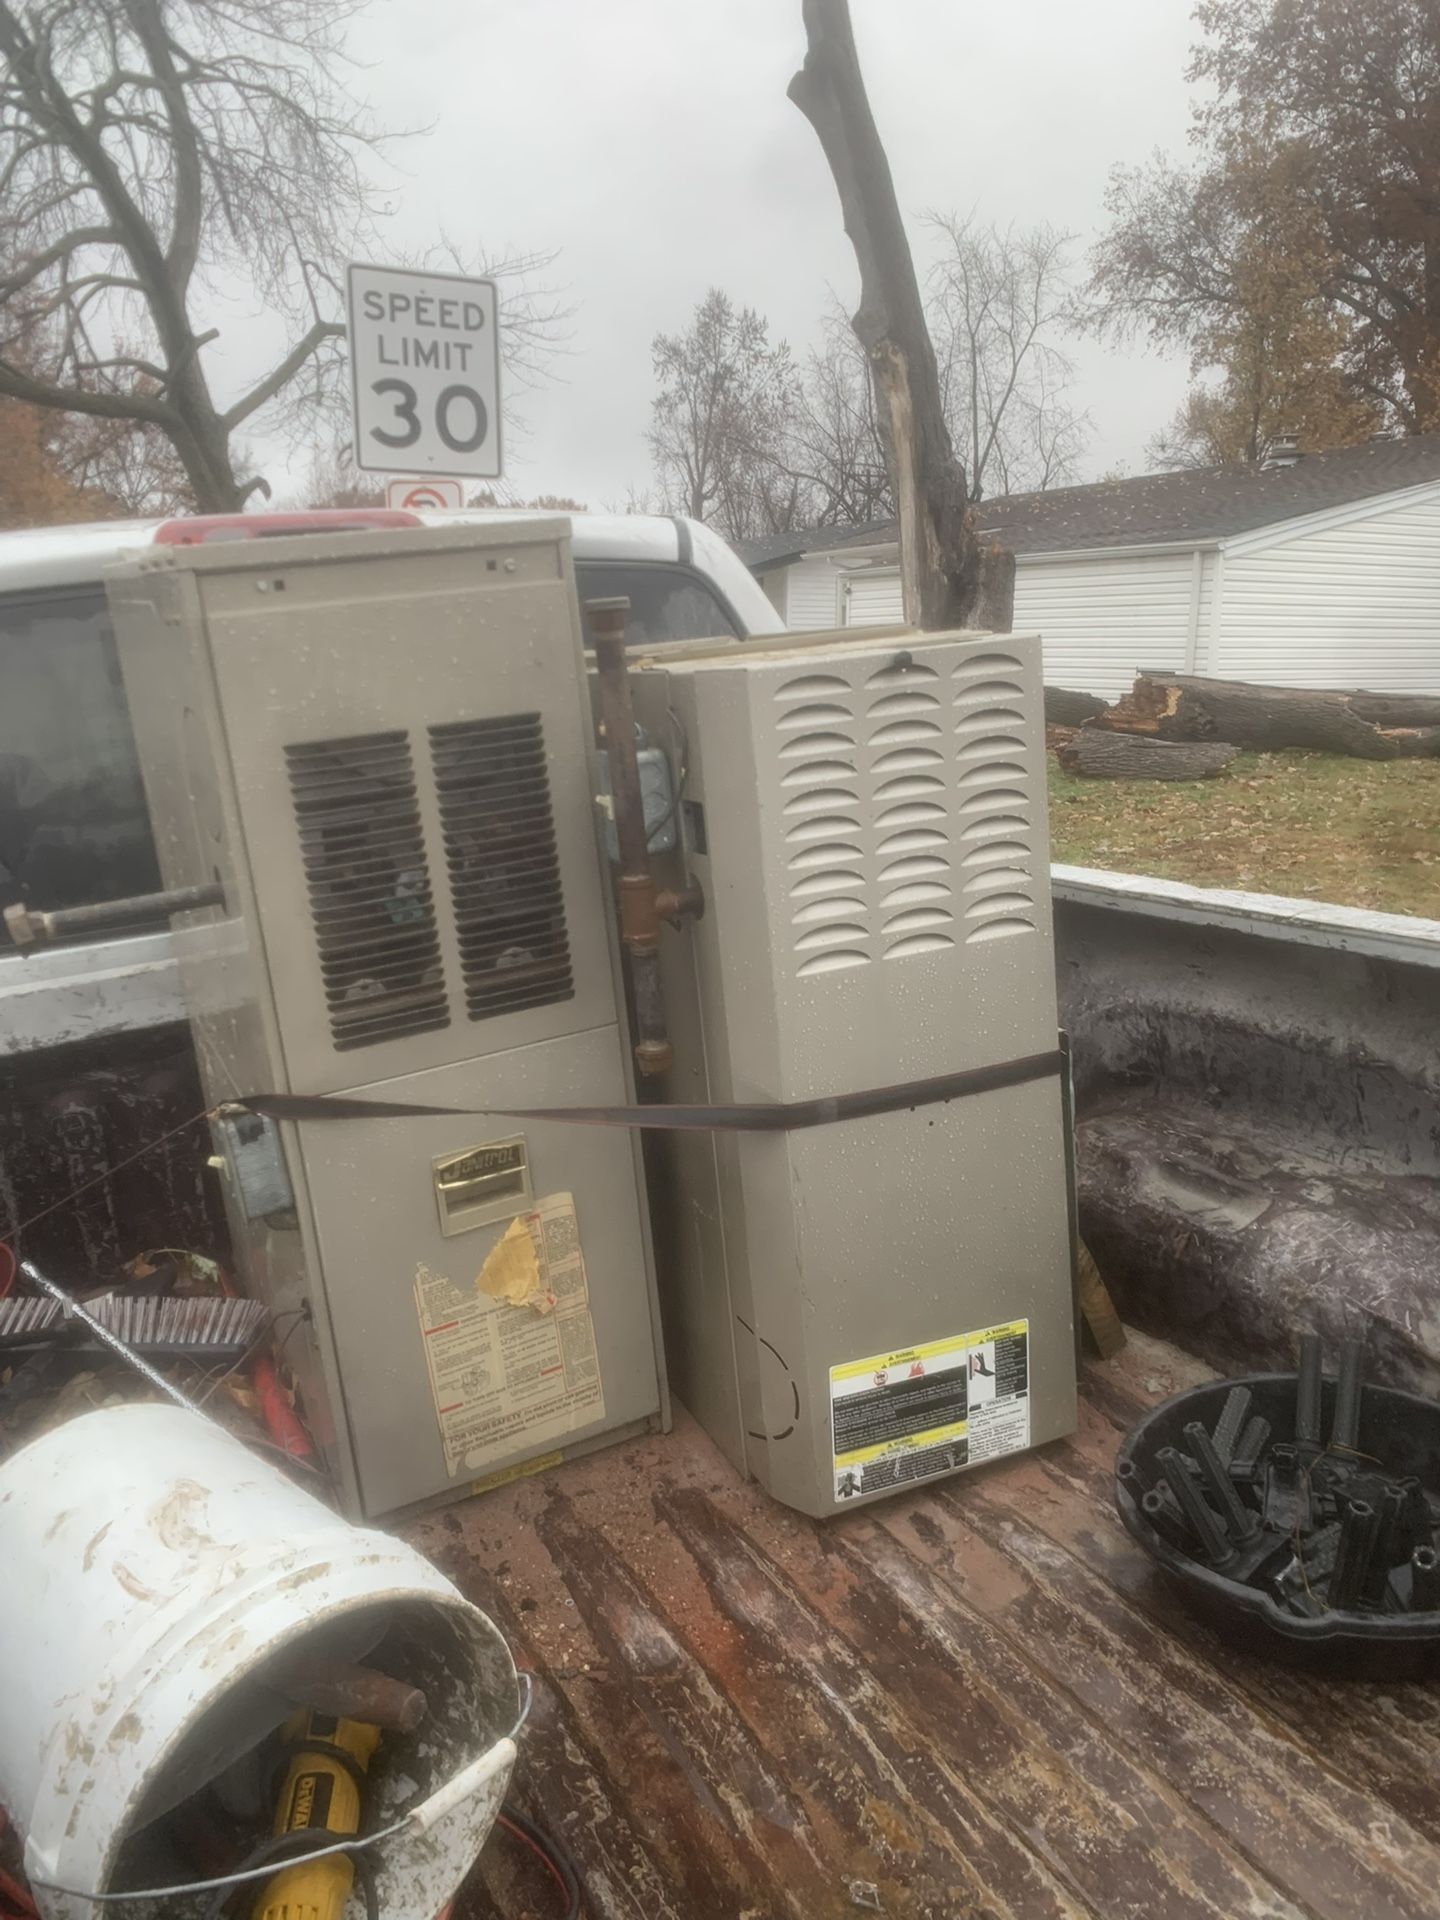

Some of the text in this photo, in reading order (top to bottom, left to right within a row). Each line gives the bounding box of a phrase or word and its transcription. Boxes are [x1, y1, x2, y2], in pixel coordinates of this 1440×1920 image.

[363, 290, 485, 331] SPEED
[378, 334, 473, 372] LIMIT
[369, 377, 488, 453] 30
